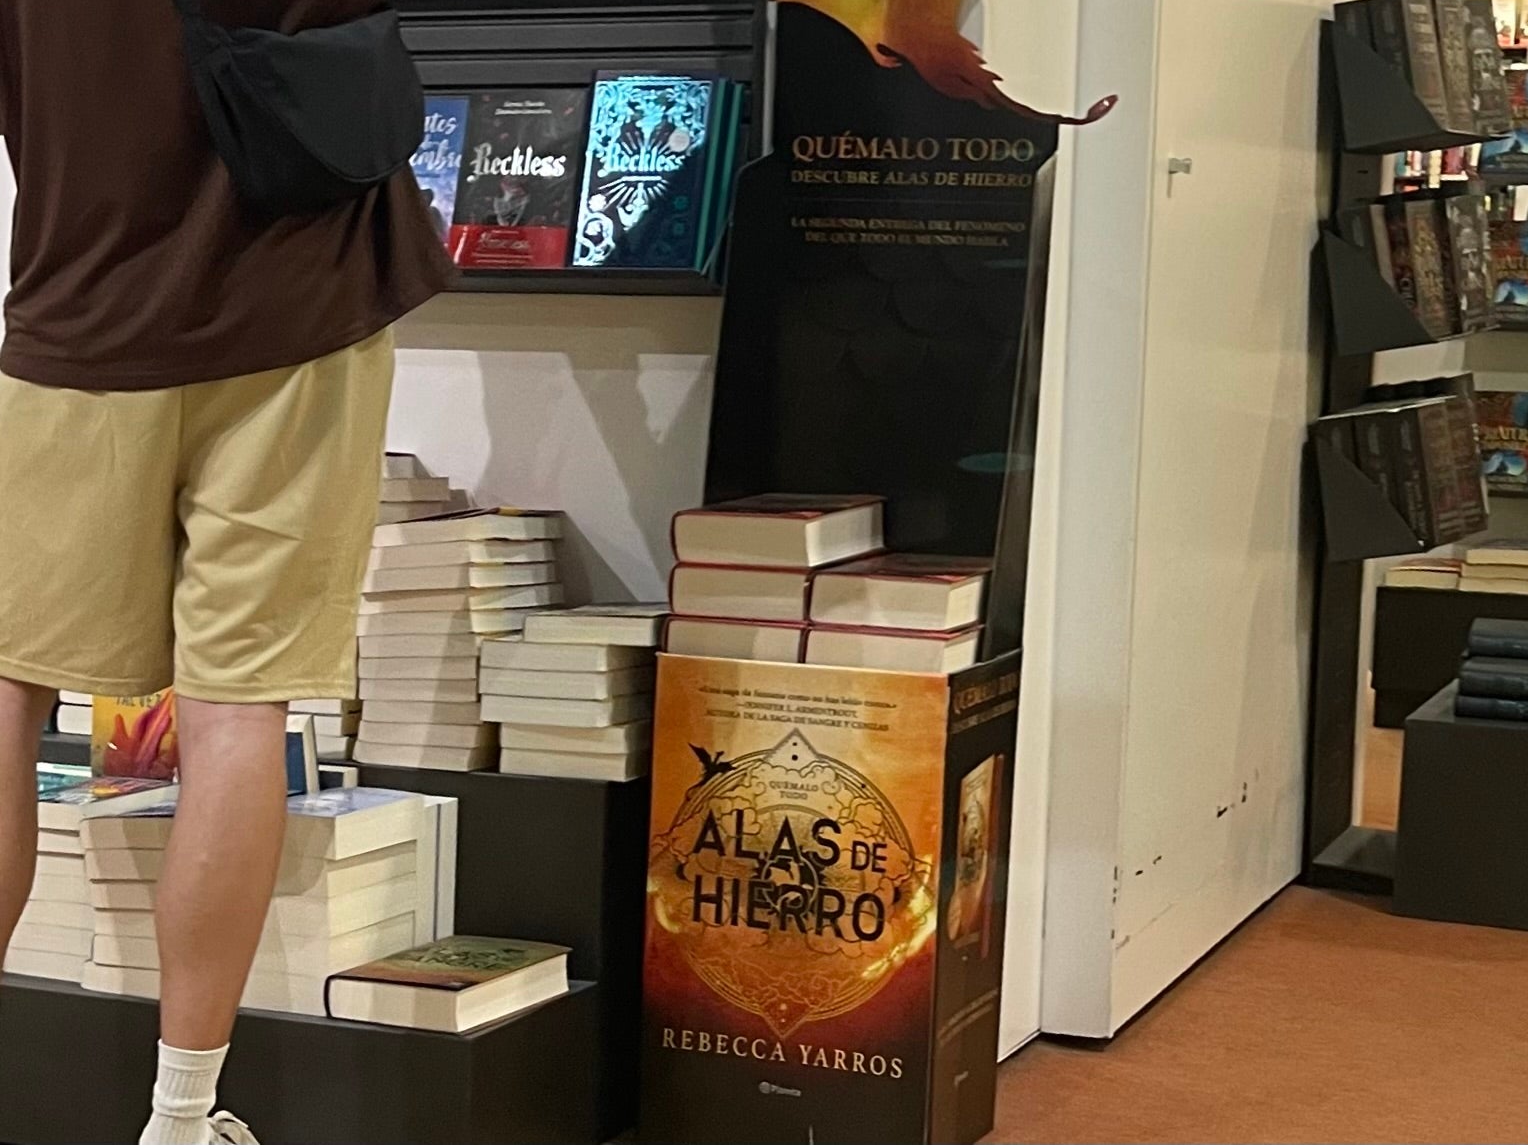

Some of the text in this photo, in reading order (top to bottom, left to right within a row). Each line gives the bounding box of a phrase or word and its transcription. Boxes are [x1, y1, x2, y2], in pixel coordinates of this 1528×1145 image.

[466, 143, 567, 183] Reckless
[598, 140, 686, 178] Reckless
[792, 130, 1035, 162] QUÉMALO TODO
[791, 170, 1033, 187] DESCUBRE ALAS DE HIERRO
[791, 217, 807, 228] LA
[692, 809, 888, 874] ALAS DE
[692, 874, 886, 943] HIERRO
[662, 1027, 904, 1080] REBECCA YARROS
